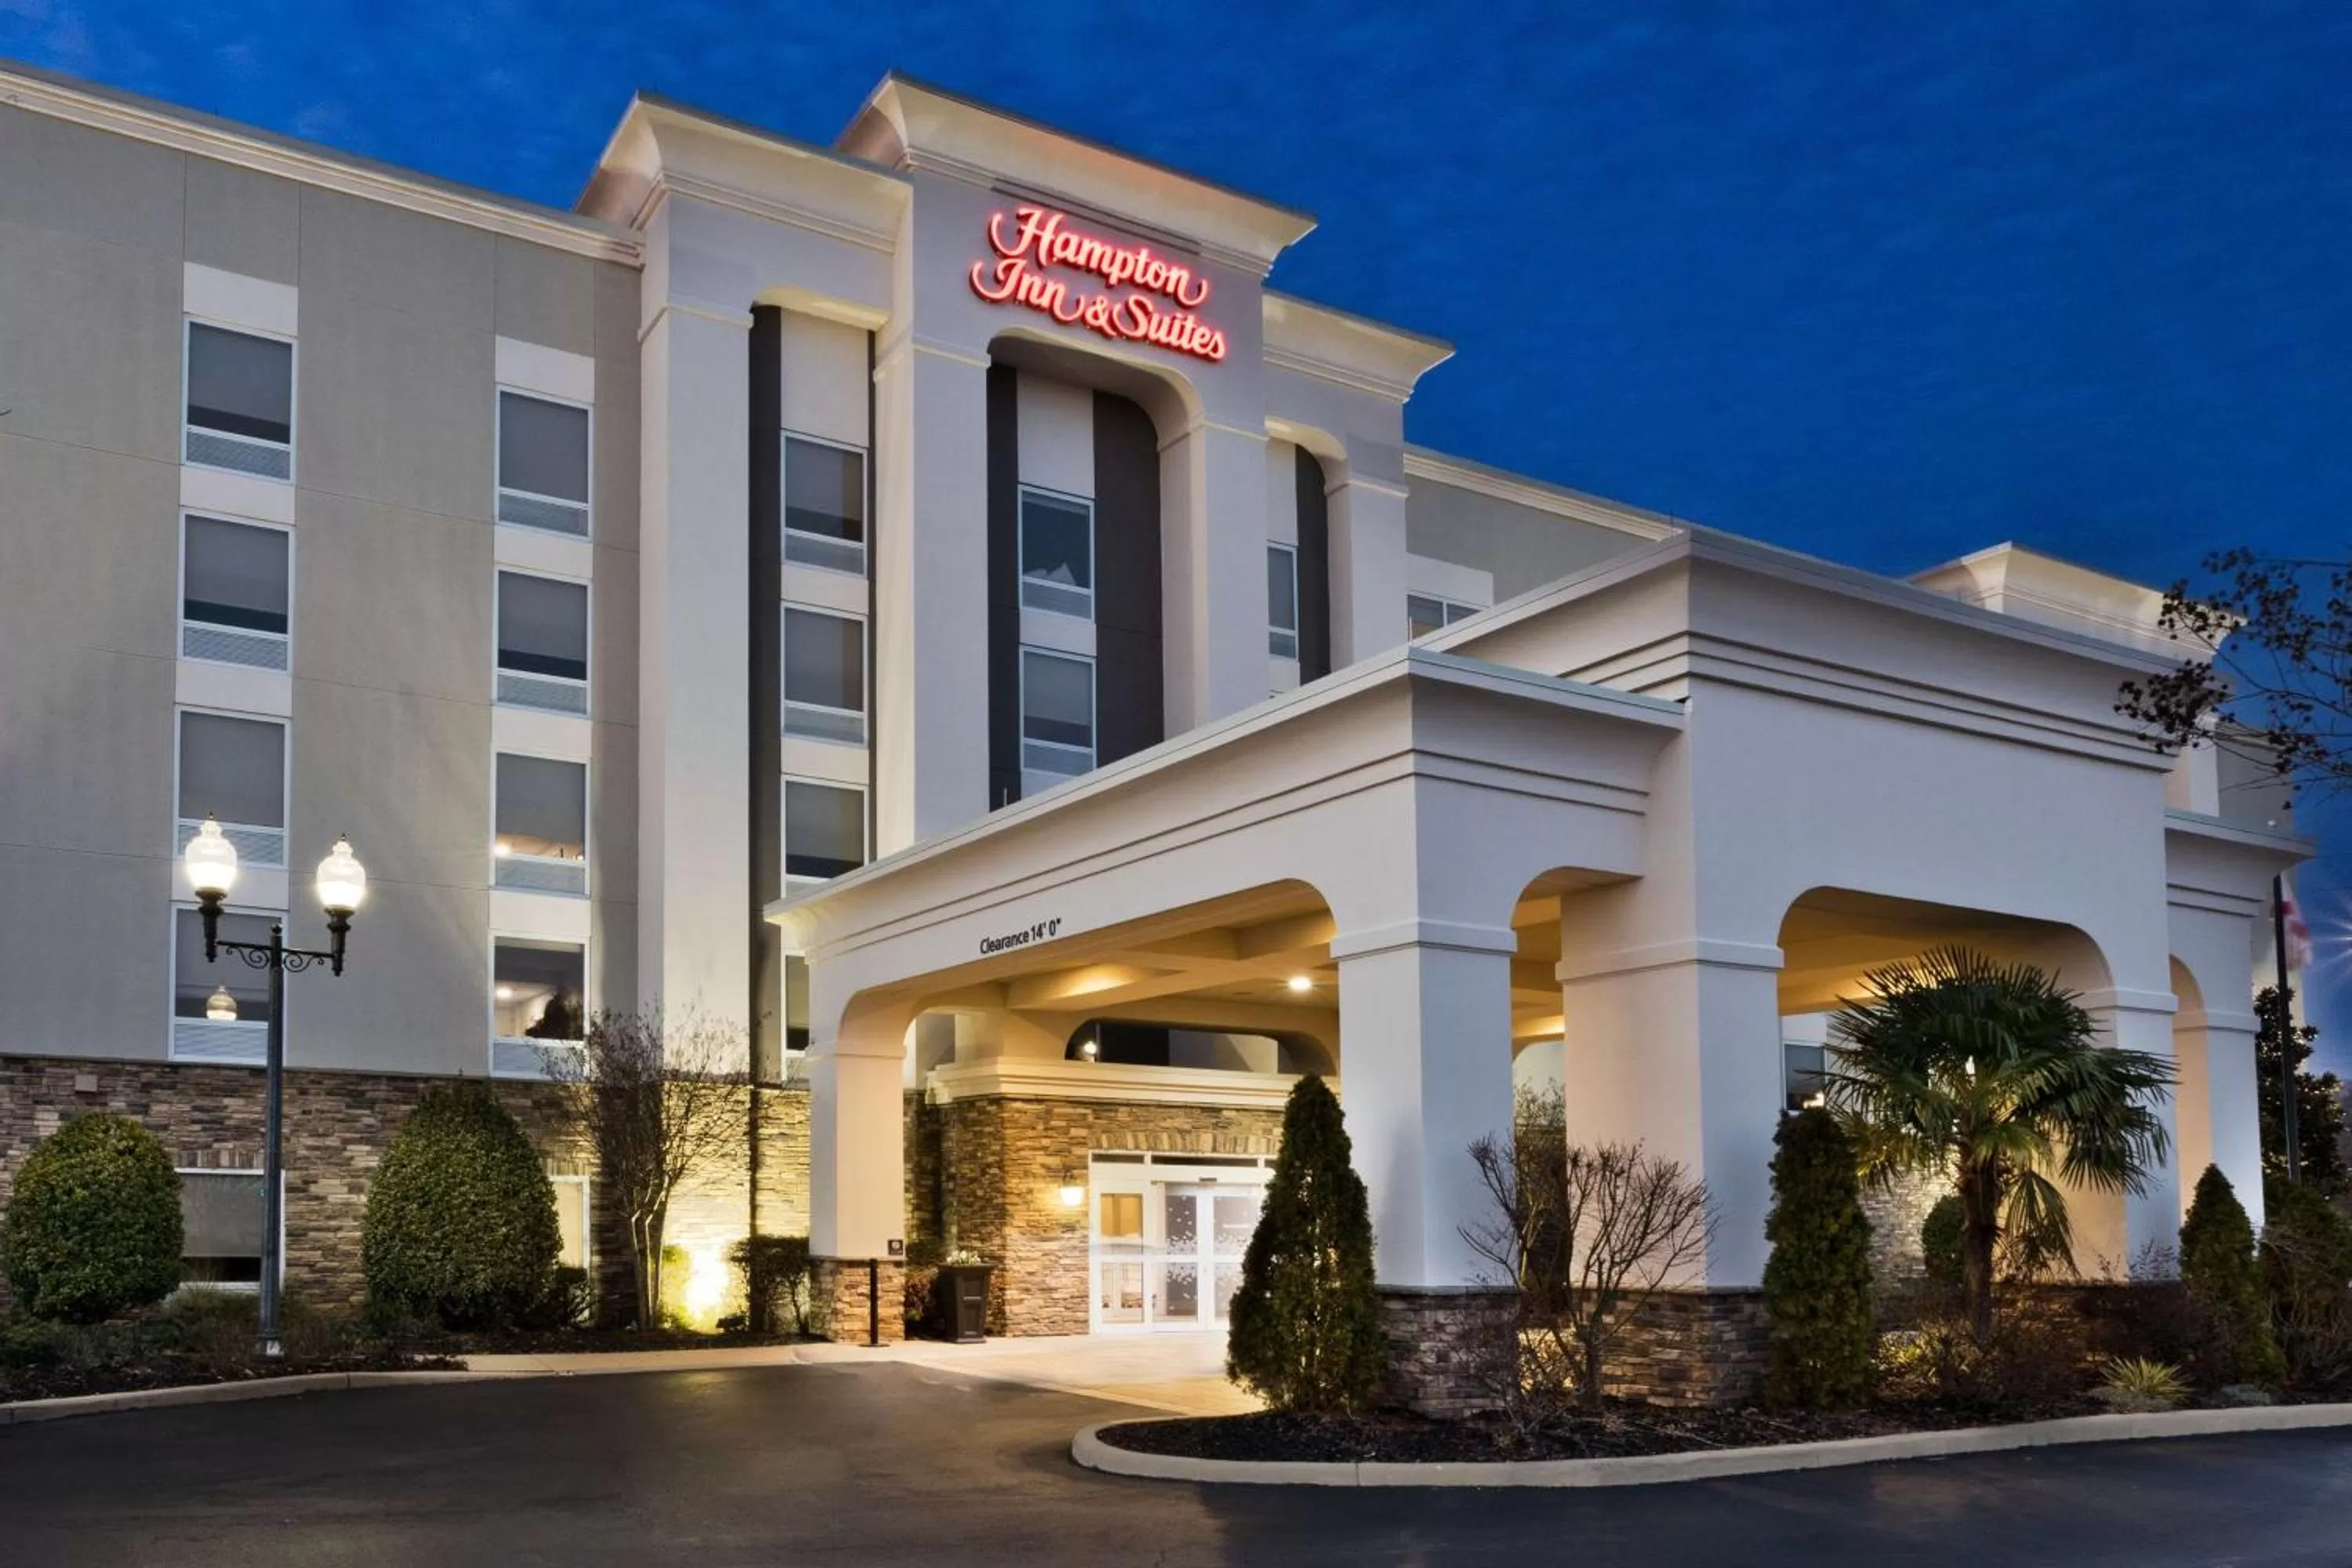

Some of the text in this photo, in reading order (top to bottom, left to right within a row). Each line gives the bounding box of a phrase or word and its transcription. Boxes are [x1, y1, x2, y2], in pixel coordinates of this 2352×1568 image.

[988, 207, 1209, 307] Hampton
[970, 258, 1085, 323] Inn
[1112, 293, 1226, 361] Suites
[980, 930, 1029, 953] Clearance
